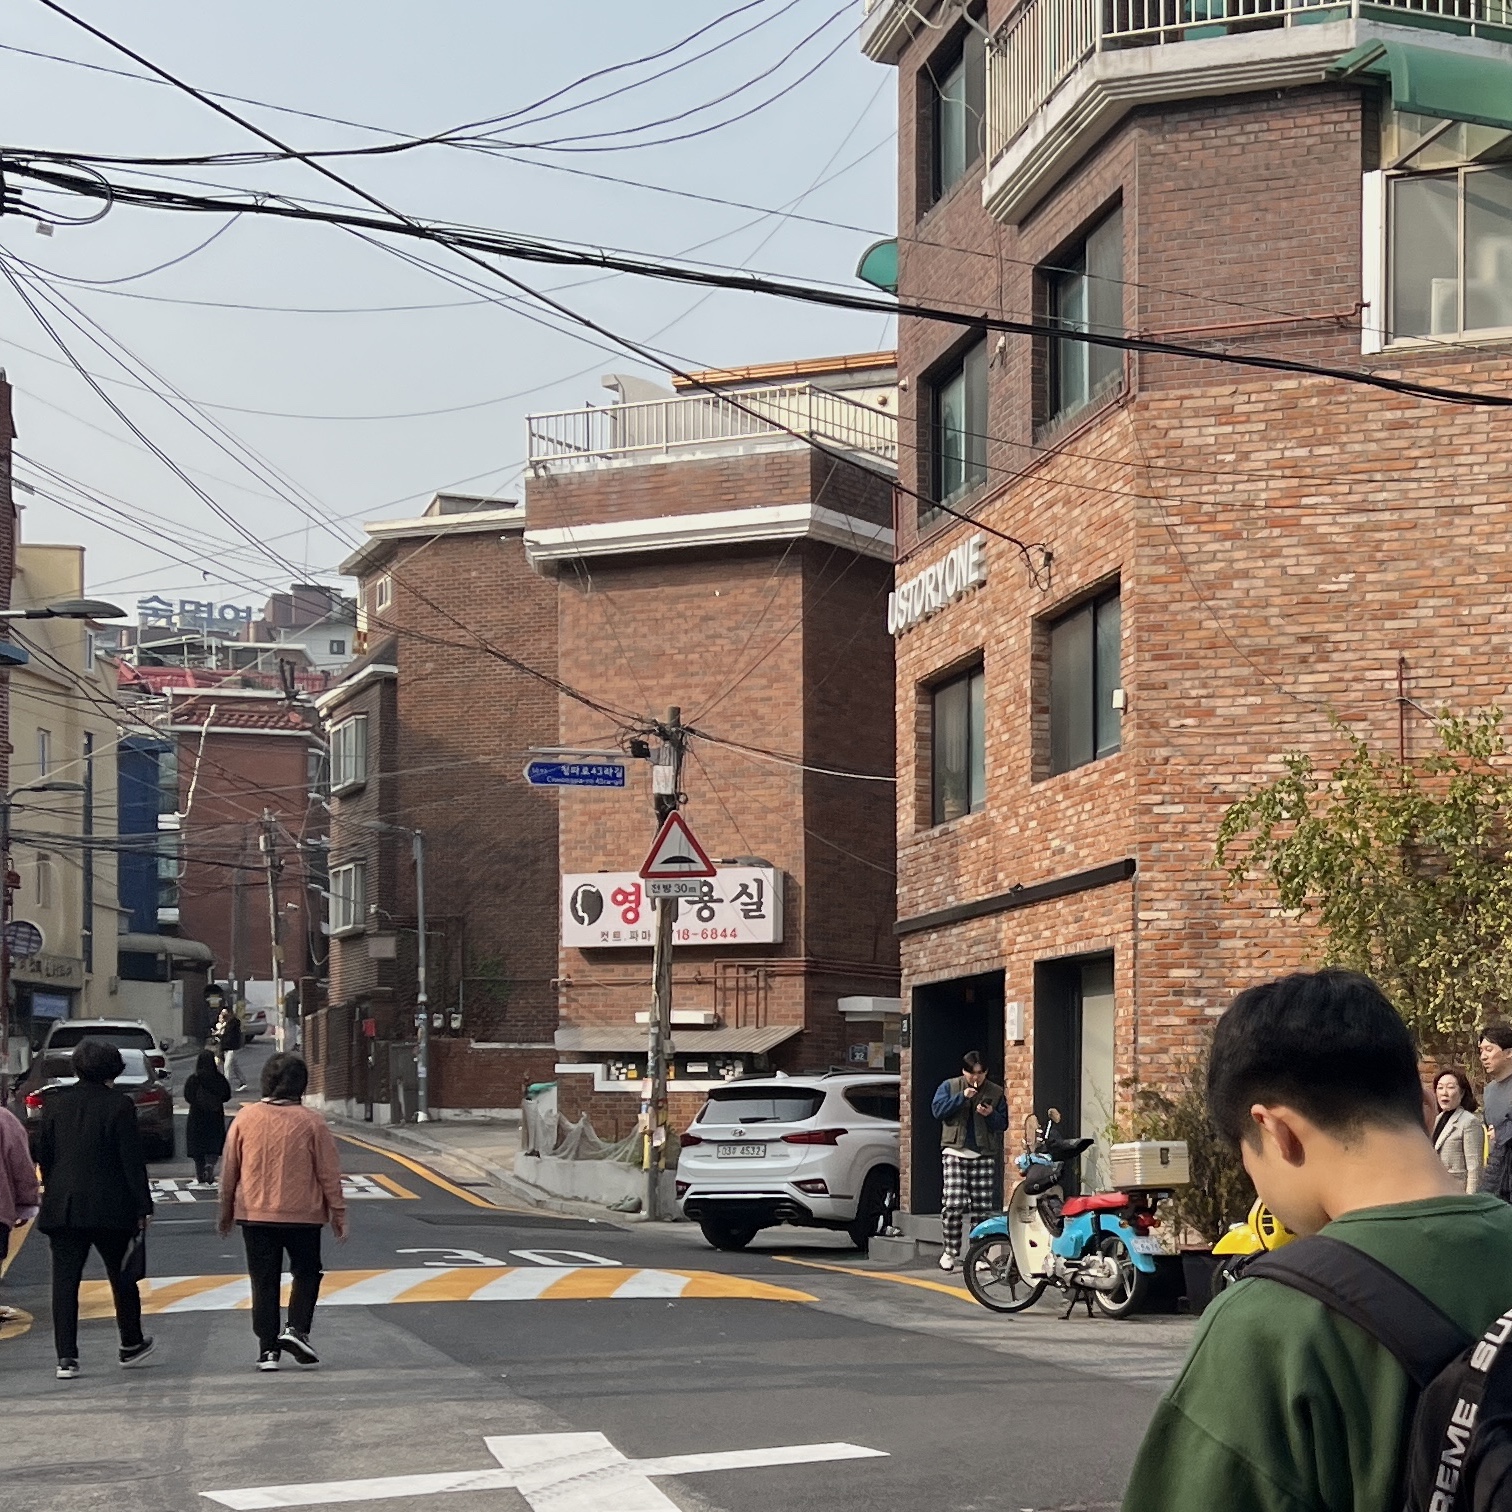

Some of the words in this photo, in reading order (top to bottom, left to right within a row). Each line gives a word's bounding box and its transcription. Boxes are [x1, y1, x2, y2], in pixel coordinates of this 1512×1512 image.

[137, 595, 264, 627] 숙명여
[650, 883, 673, 894] 전방
[674, 883, 697, 894] 30m
[671, 927, 738, 941] 18-6844
[396, 1247, 623, 1267] 30
